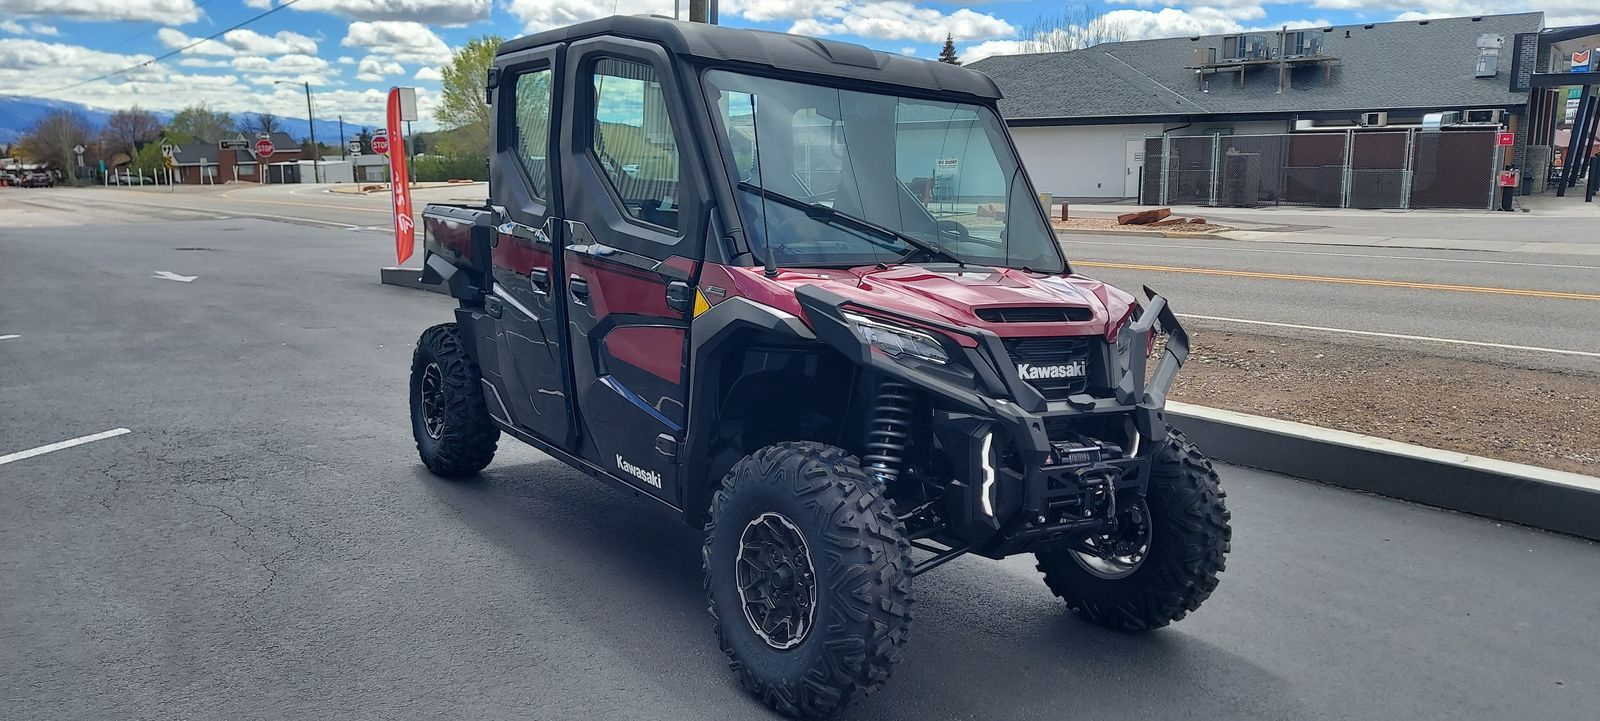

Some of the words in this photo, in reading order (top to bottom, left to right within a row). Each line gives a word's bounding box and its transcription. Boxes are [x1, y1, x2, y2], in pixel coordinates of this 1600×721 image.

[257, 144, 272, 152] STOP
[1018, 361, 1086, 380] Kawasaki
[616, 453, 662, 489] Kawasaki
